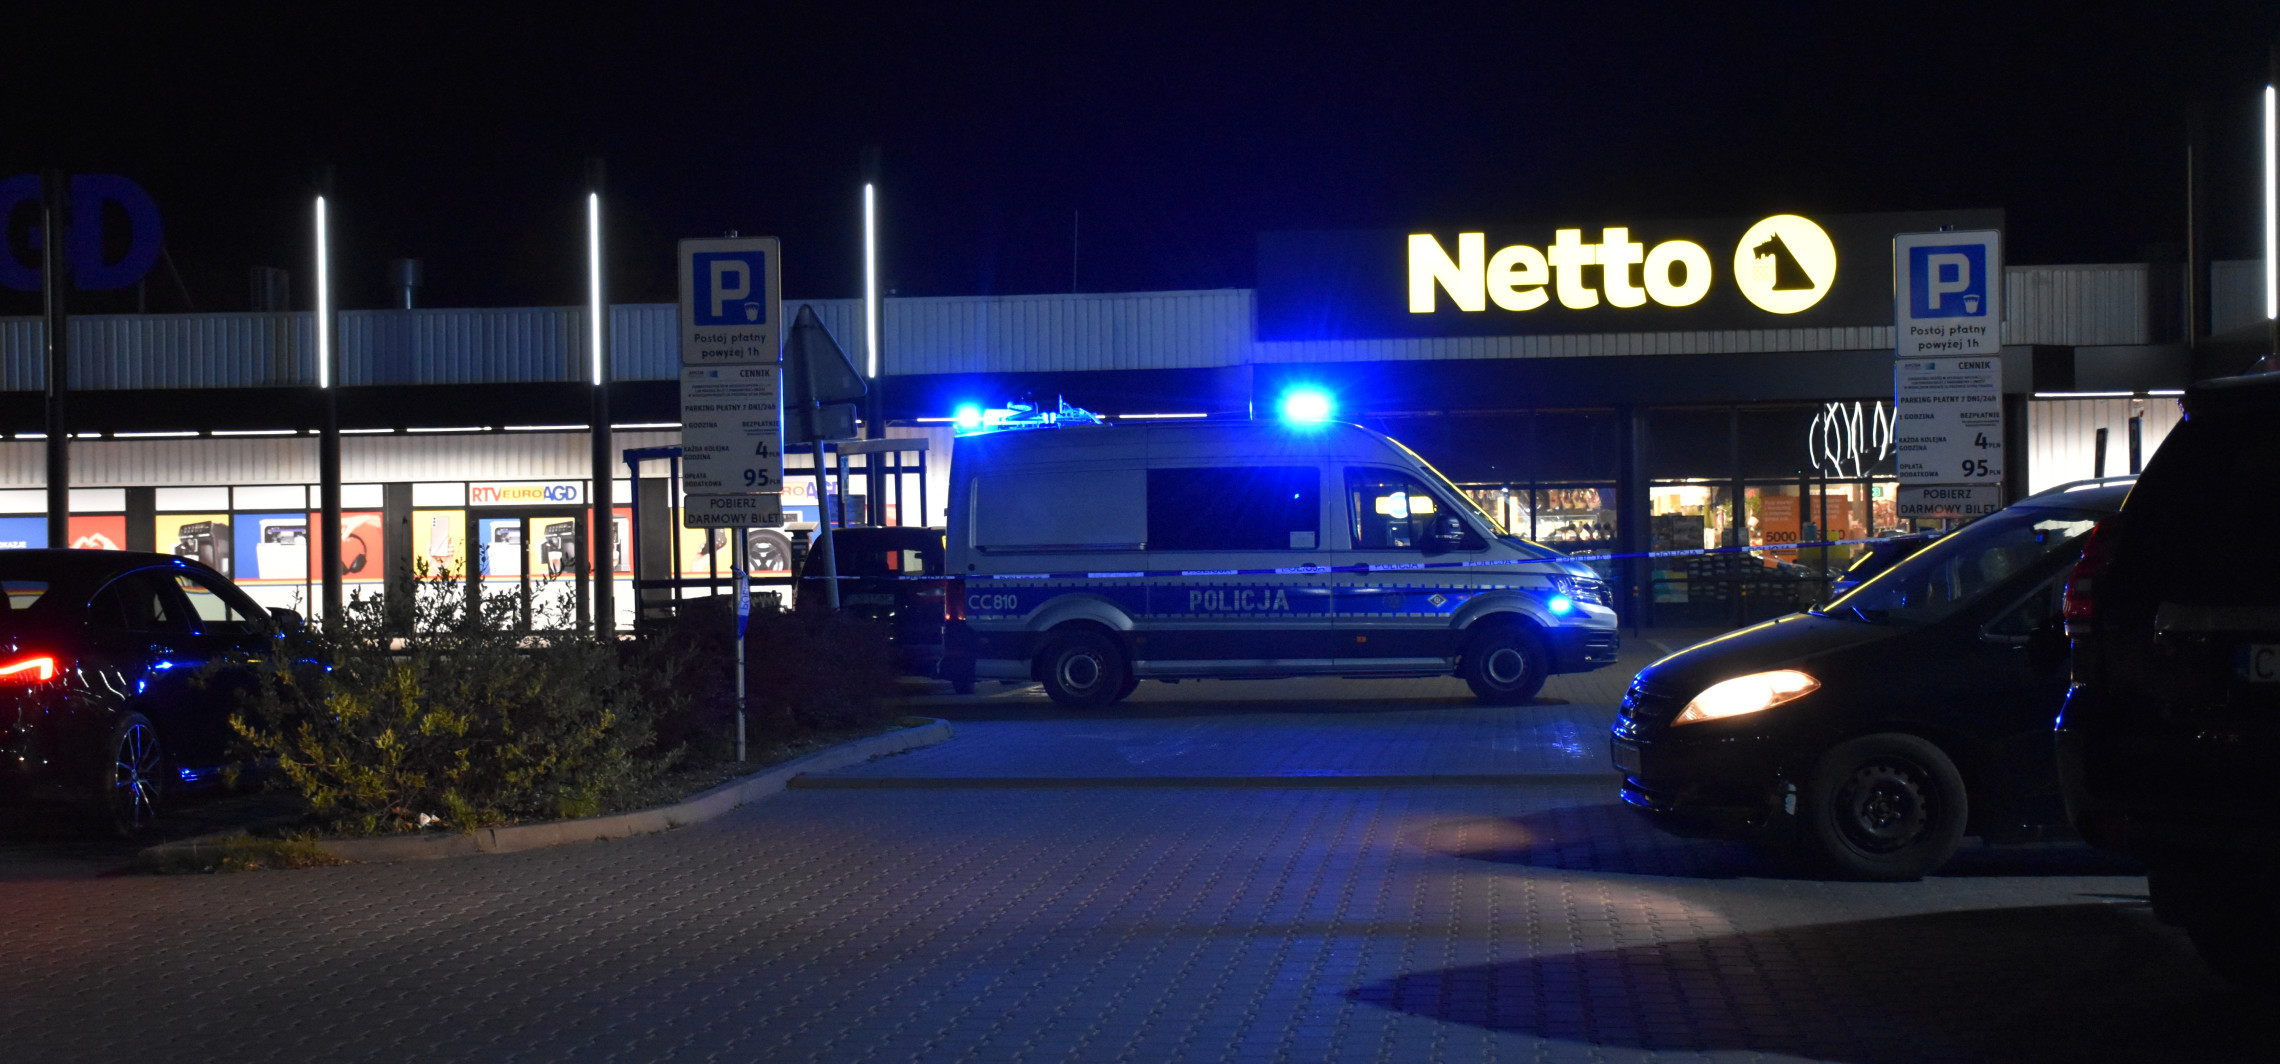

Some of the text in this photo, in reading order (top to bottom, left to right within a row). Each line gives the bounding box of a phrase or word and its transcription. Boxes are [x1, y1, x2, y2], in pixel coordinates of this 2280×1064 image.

[1408, 226, 1712, 313] Netto
[1928, 254, 1970, 310] P
[710, 260, 750, 317] P
[1911, 324, 1986, 336] Postój płatny
[694, 332, 766, 344] Postój płatny
[1918, 338, 1979, 351] powyżej 1h
[702, 347, 760, 359] powyżej 1h
[1958, 362, 1991, 370] CENNIK
[740, 369, 770, 378] CENNIK
[1901, 396, 1931, 404] PARKING
[685, 404, 714, 412] PARKING
[1974, 432, 1988, 450] 4
[756, 441, 768, 459] 4
[1962, 460, 1988, 477] 95
[744, 469, 768, 487] 95
[472, 486, 577, 502] RTV EURO AGD
[1924, 489, 1972, 499] POBIERZ
[710, 498, 756, 508] POBIERZ
[1901, 504, 1995, 514] DARMOWY BILET
[688, 514, 780, 524] DARMOWY BILET
[1766, 531, 1796, 542] 5000
[968, 594, 1017, 610] CC810
[1189, 589, 1290, 611] POLICJA
